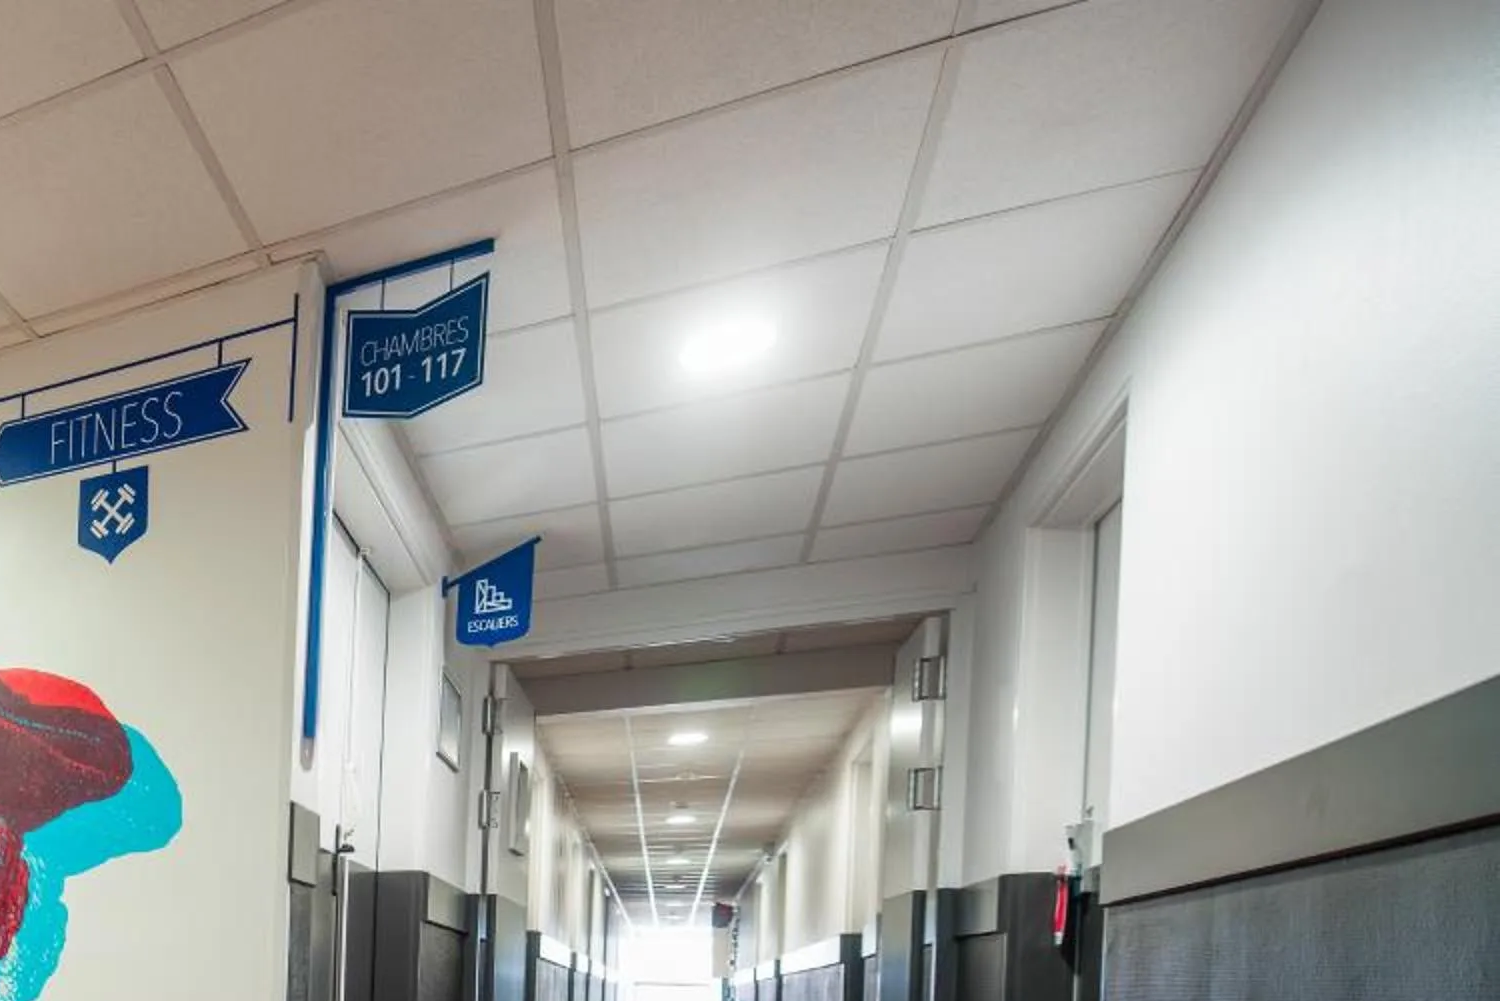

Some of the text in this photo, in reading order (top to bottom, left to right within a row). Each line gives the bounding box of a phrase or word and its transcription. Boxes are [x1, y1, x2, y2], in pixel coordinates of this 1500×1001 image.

[361, 316, 469, 367] CHAMBRES
[361, 364, 401, 397] 101
[421, 348, 467, 383] 117
[49, 391, 184, 466] FITNESS
[467, 615, 519, 633] ESCALIERS
